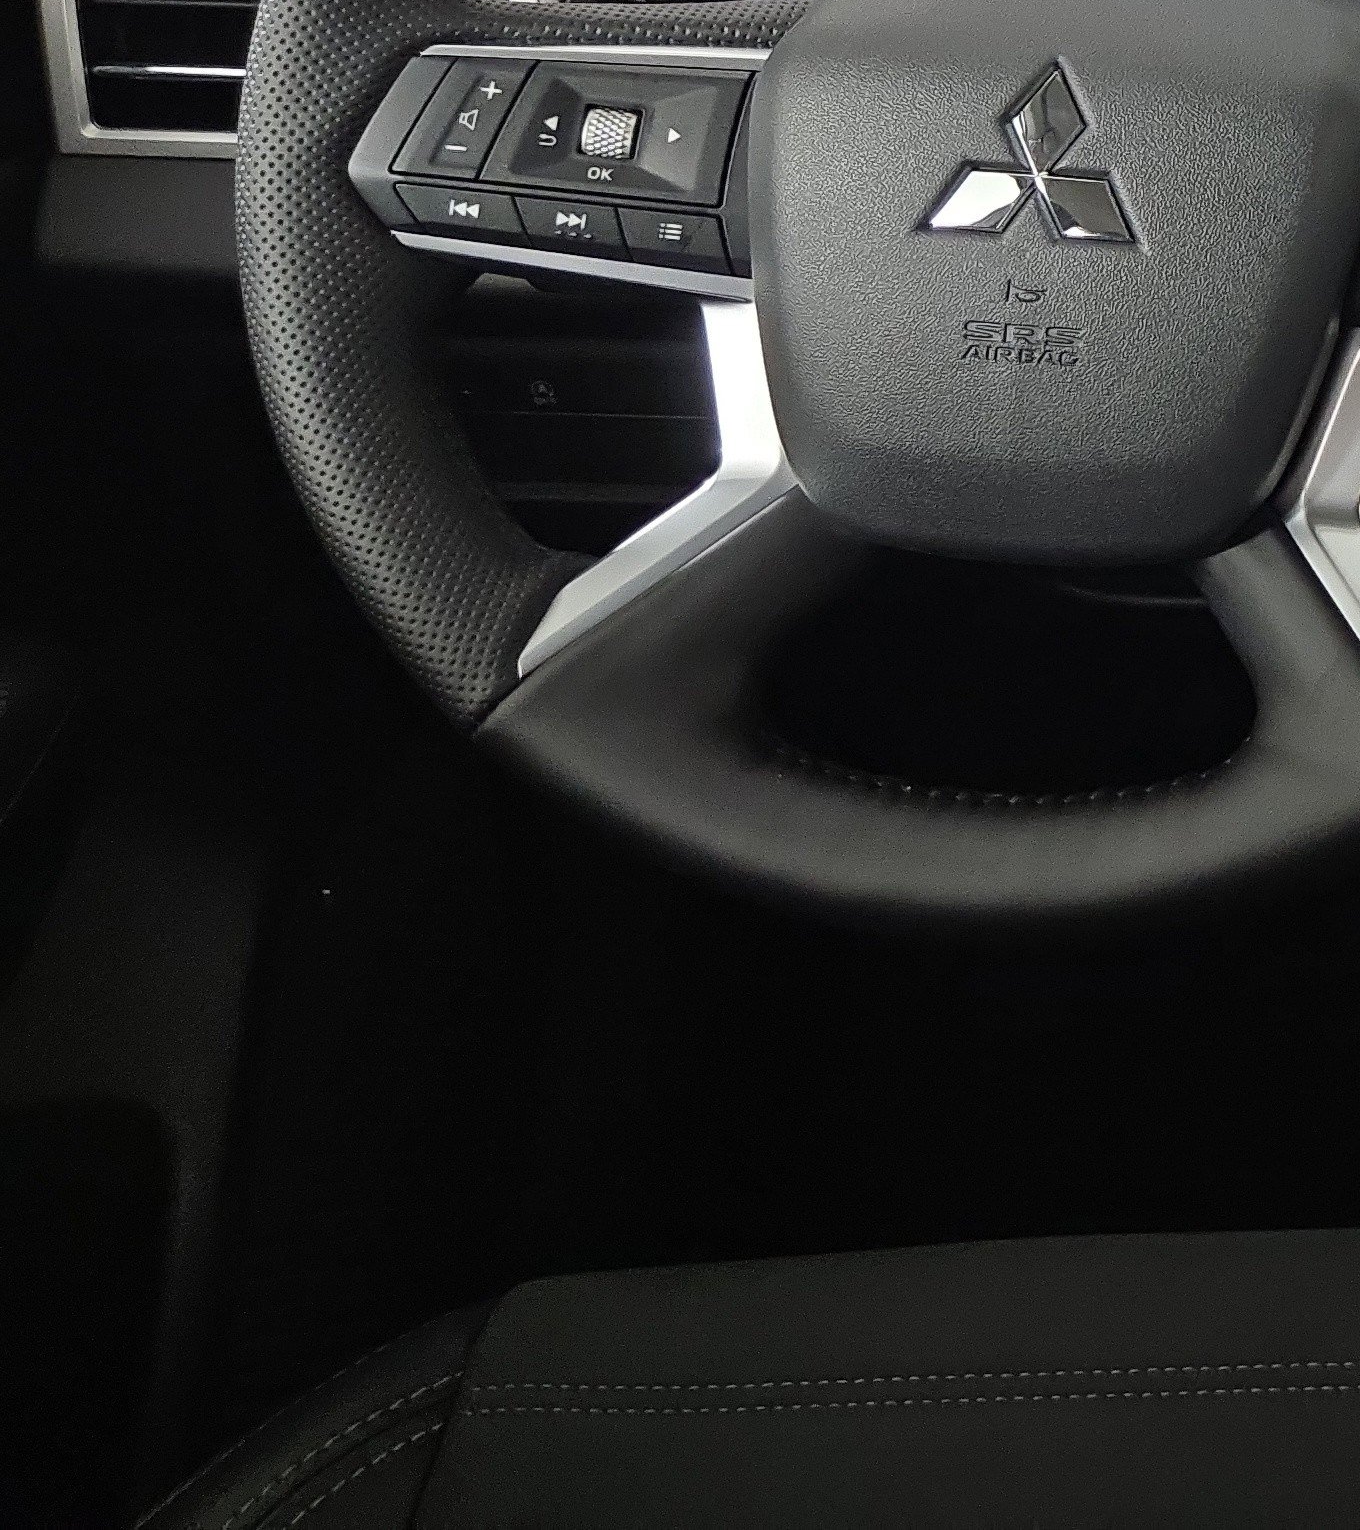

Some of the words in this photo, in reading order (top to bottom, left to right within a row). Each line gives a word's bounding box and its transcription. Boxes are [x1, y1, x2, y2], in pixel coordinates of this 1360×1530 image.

[587, 167, 614, 181] OK
[963, 320, 1085, 347] SRS
[961, 345, 1079, 366] AIRBAG
